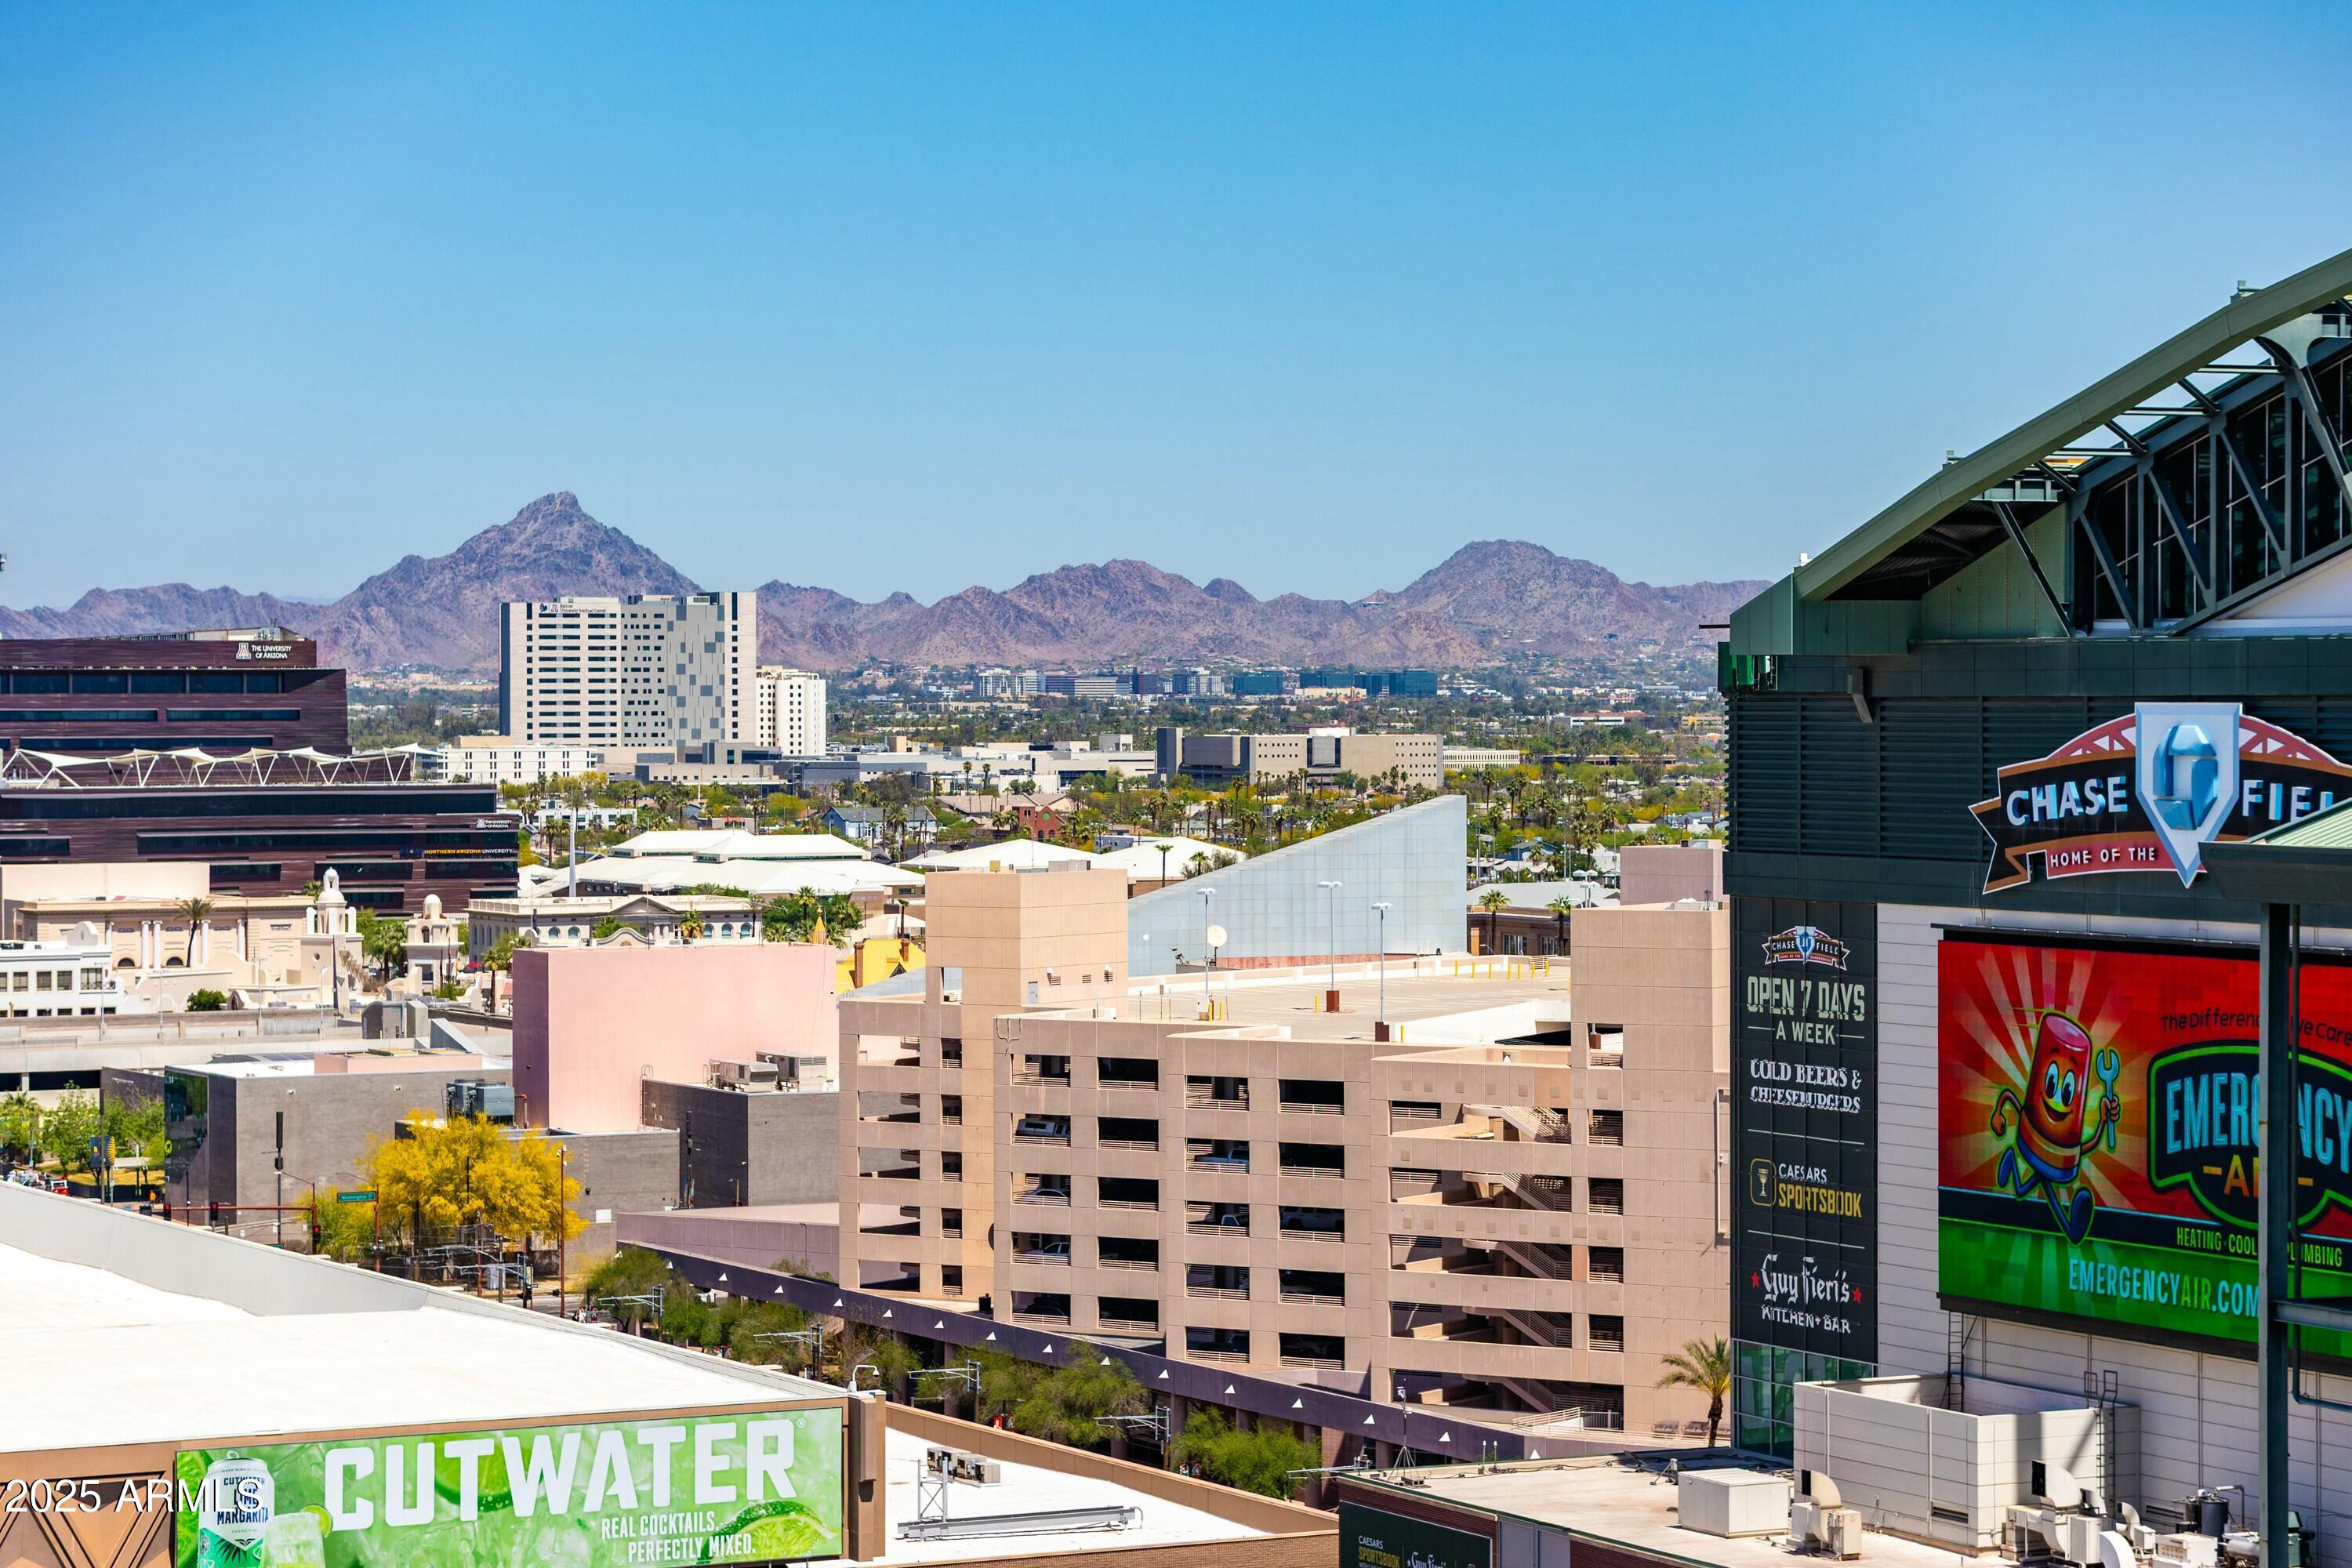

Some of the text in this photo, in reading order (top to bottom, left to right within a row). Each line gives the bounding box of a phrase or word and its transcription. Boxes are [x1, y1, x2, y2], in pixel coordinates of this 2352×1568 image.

[2007, 776, 2334, 826] CHASE FIE
[2050, 847, 2155, 868] HOME OF THE
[1772, 941, 1795, 950] CHASE
[1747, 975, 1865, 1022] OPEN 7 DAYS
[1776, 1020, 1835, 1045] A WEEK
[2161, 1014, 2187, 1031] The
[2189, 1008, 2259, 1029] Differen
[1750, 1058, 1862, 1090] COLD BEERS &
[1750, 1085, 1860, 1114] CHEESEBURGERS
[1778, 1163, 1828, 1184] CAESARS
[1778, 1183, 1862, 1218] SPORTSBOOK
[2176, 1227, 2343, 1267] HEATING COOL LMBING
[1760, 1254, 1850, 1305] Guy Fieri's
[2068, 1258, 2259, 1318] EMERGENCYAIR.COM
[1761, 1305, 1814, 1329] KITCHEN
[1823, 1314, 1851, 1334] BAR
[217, 1506, 269, 1526] MARGARITA
[601, 1511, 719, 1540] REAL COCKTAILS.
[628, 1533, 756, 1563] PERFECTLY MIXED.
[1358, 1535, 1384, 1549] CAESARS
[1359, 1546, 1400, 1568] SPORTSBOOK
